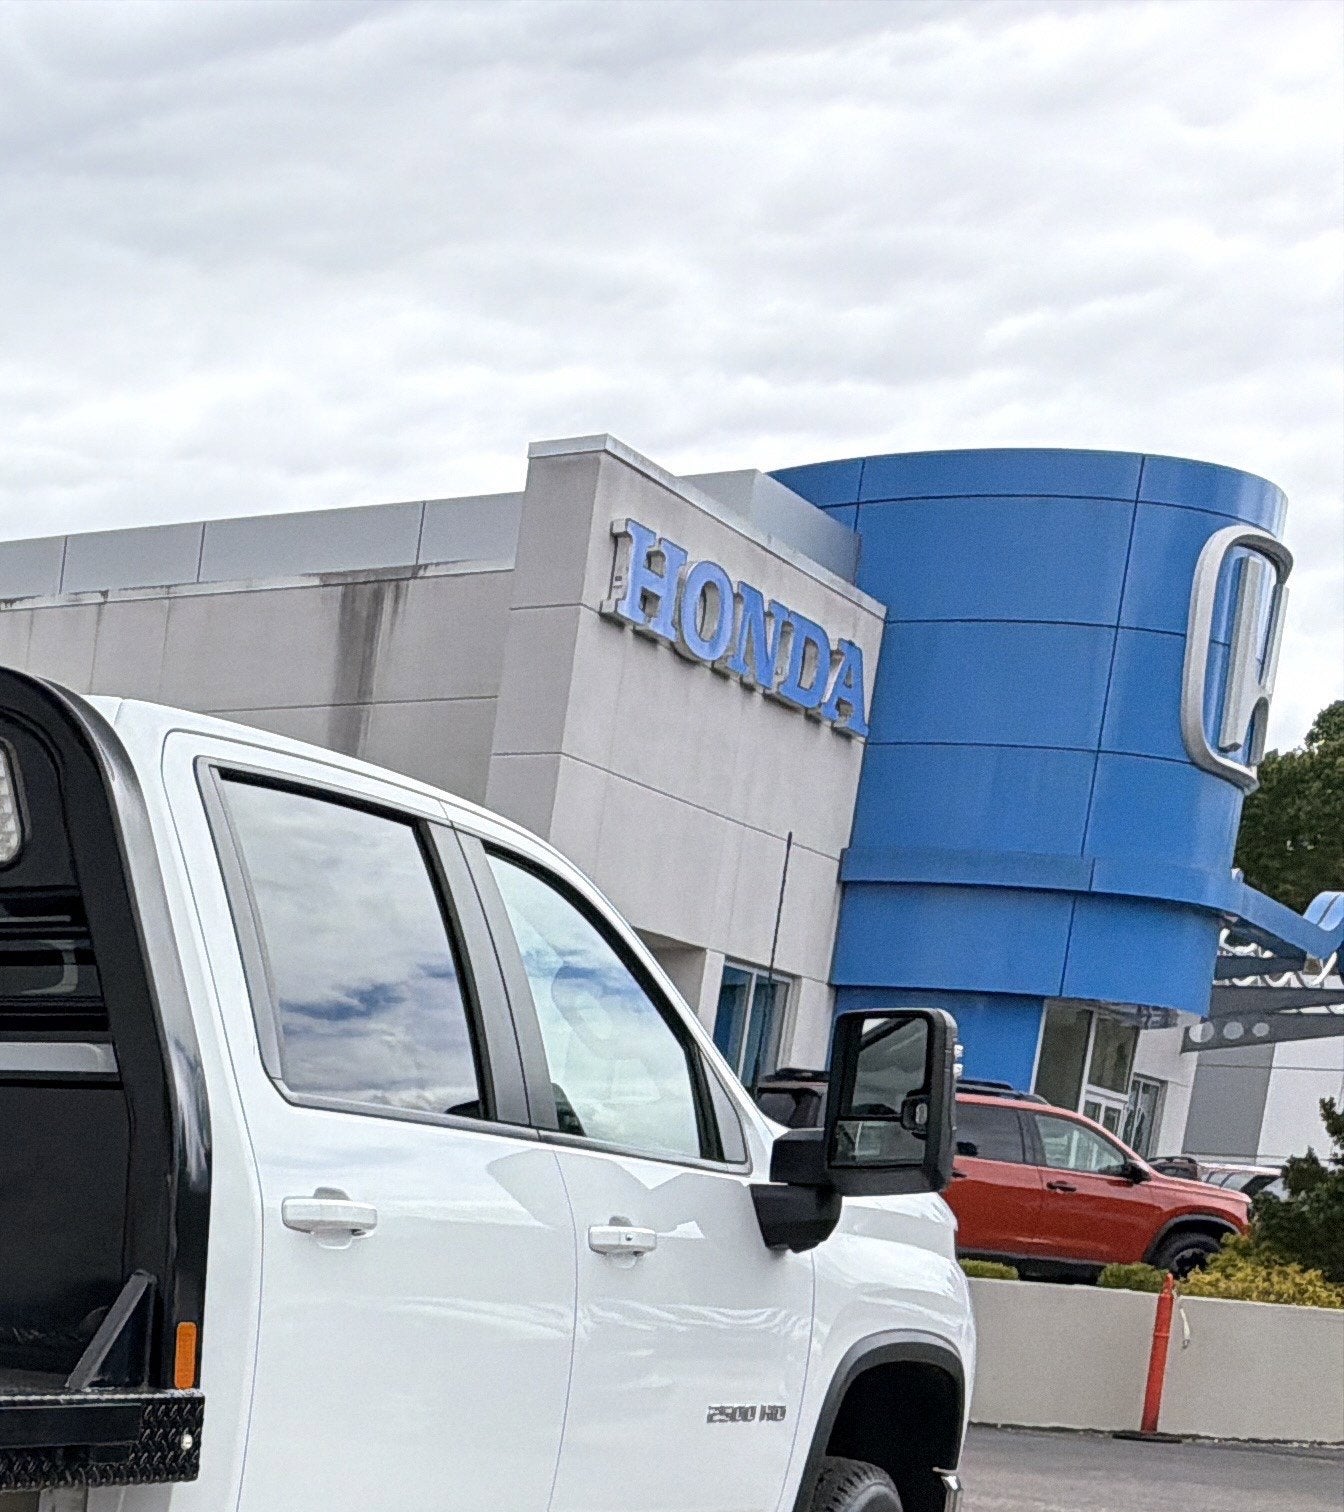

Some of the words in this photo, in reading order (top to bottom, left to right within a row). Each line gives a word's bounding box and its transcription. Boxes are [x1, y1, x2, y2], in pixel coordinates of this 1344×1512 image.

[601, 517, 869, 740] HONDA
[706, 1404, 757, 1424] 2500
[759, 1403, 787, 1422] HD
